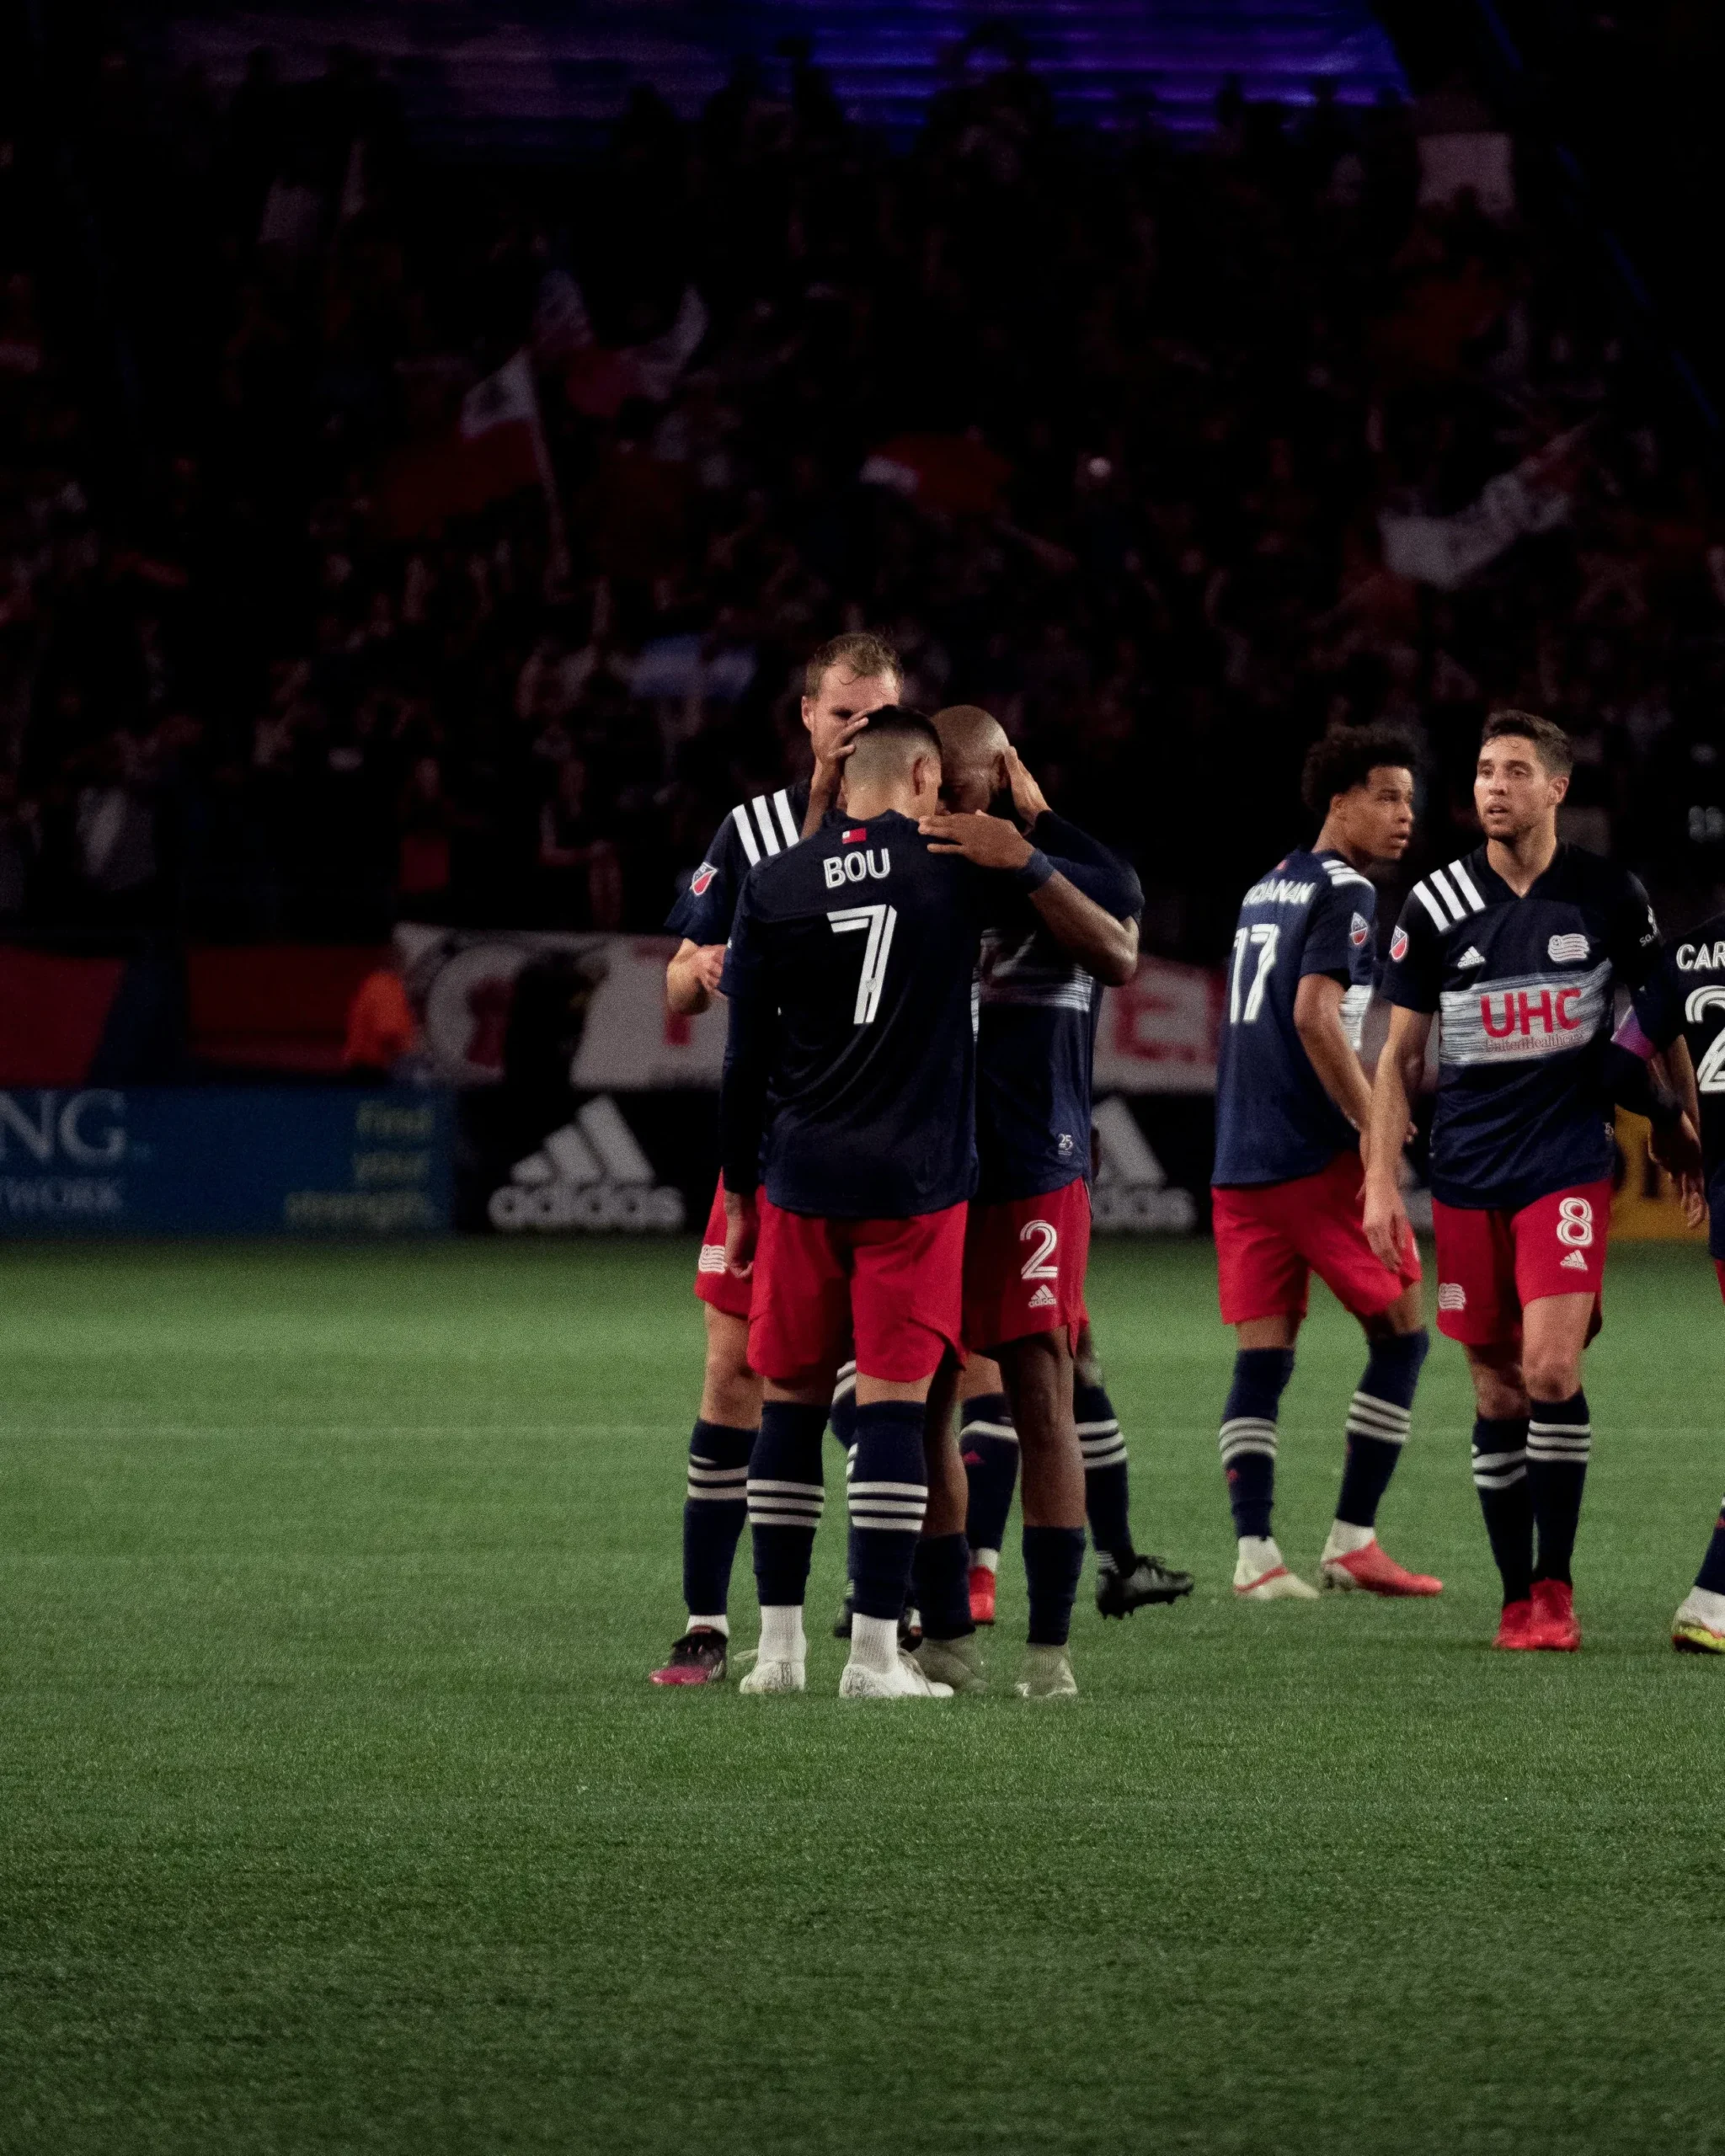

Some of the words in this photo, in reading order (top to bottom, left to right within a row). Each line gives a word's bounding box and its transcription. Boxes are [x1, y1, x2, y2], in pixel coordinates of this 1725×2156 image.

[823, 848, 890, 889] BOU
[826, 904, 897, 1025] 7
[1231, 924, 1280, 1024] 17
[1676, 941, 1725, 970] CAR
[1481, 988, 1582, 1038] UHC
[1685, 985, 1725, 1094] 2
[1557, 1197, 1593, 1246] 8
[1019, 1219, 1059, 1280] 2
